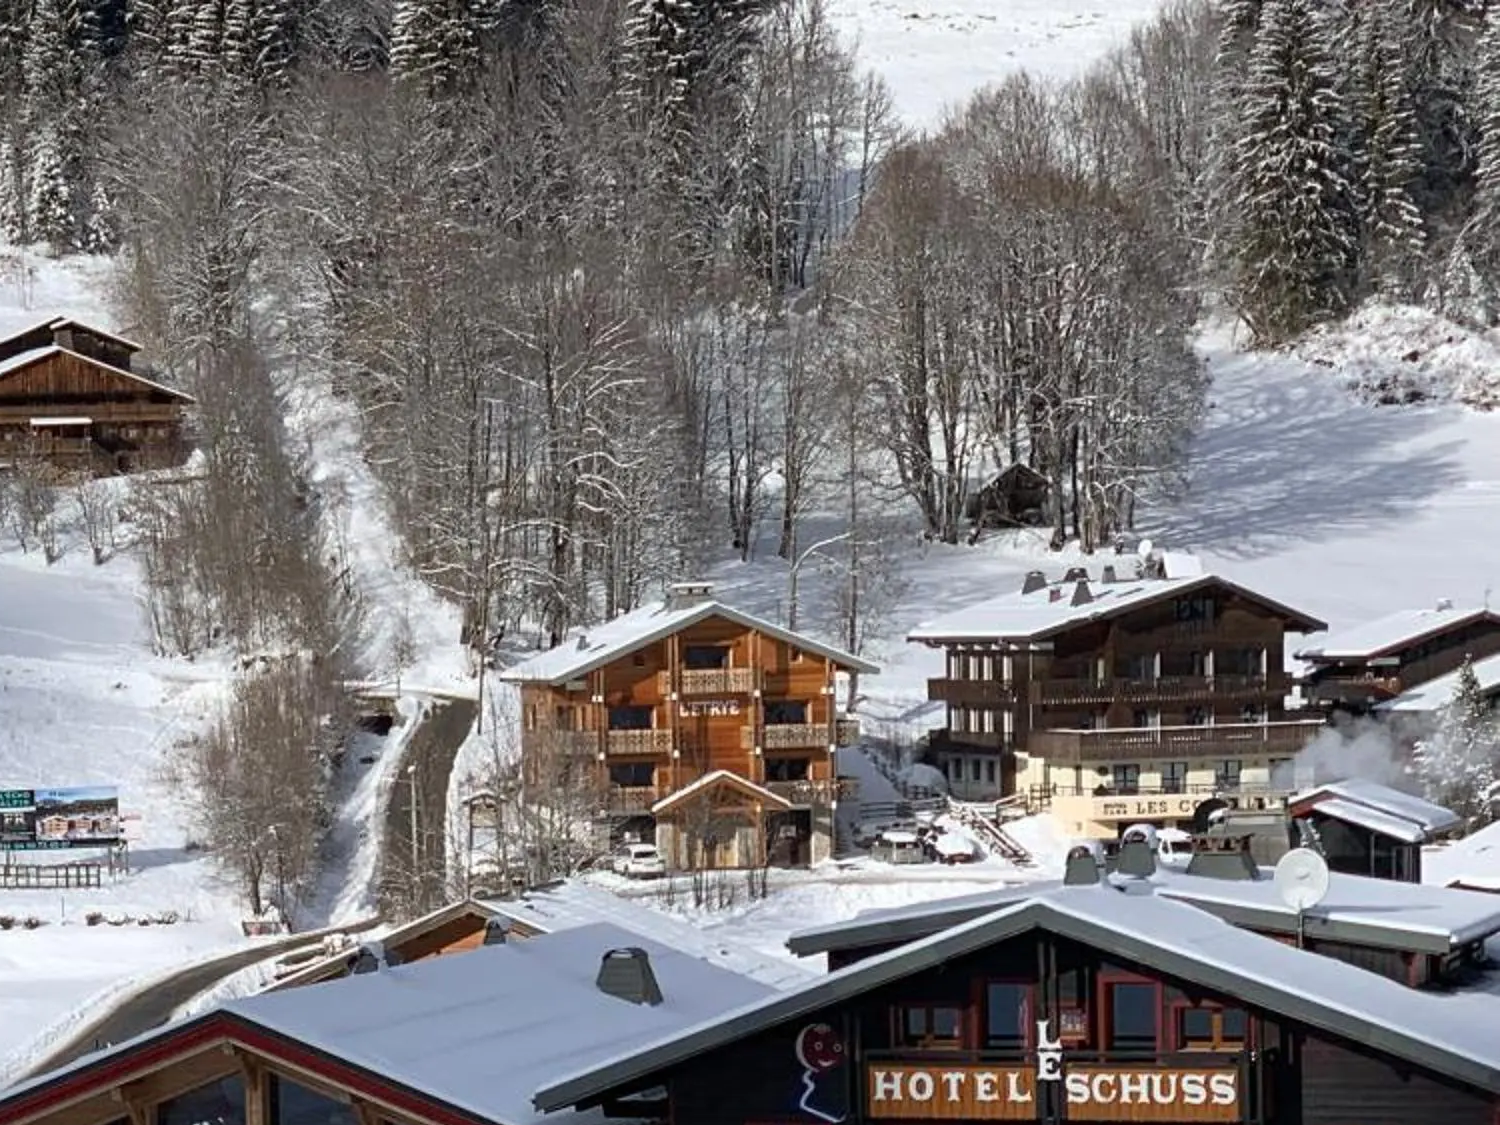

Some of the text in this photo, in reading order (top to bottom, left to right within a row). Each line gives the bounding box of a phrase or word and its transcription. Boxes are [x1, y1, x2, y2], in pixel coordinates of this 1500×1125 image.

[1136, 801, 1168, 814] LES
[1037, 1020, 1062, 1081] LE
[873, 1071, 1237, 1105] HOTEL SCHUSS
